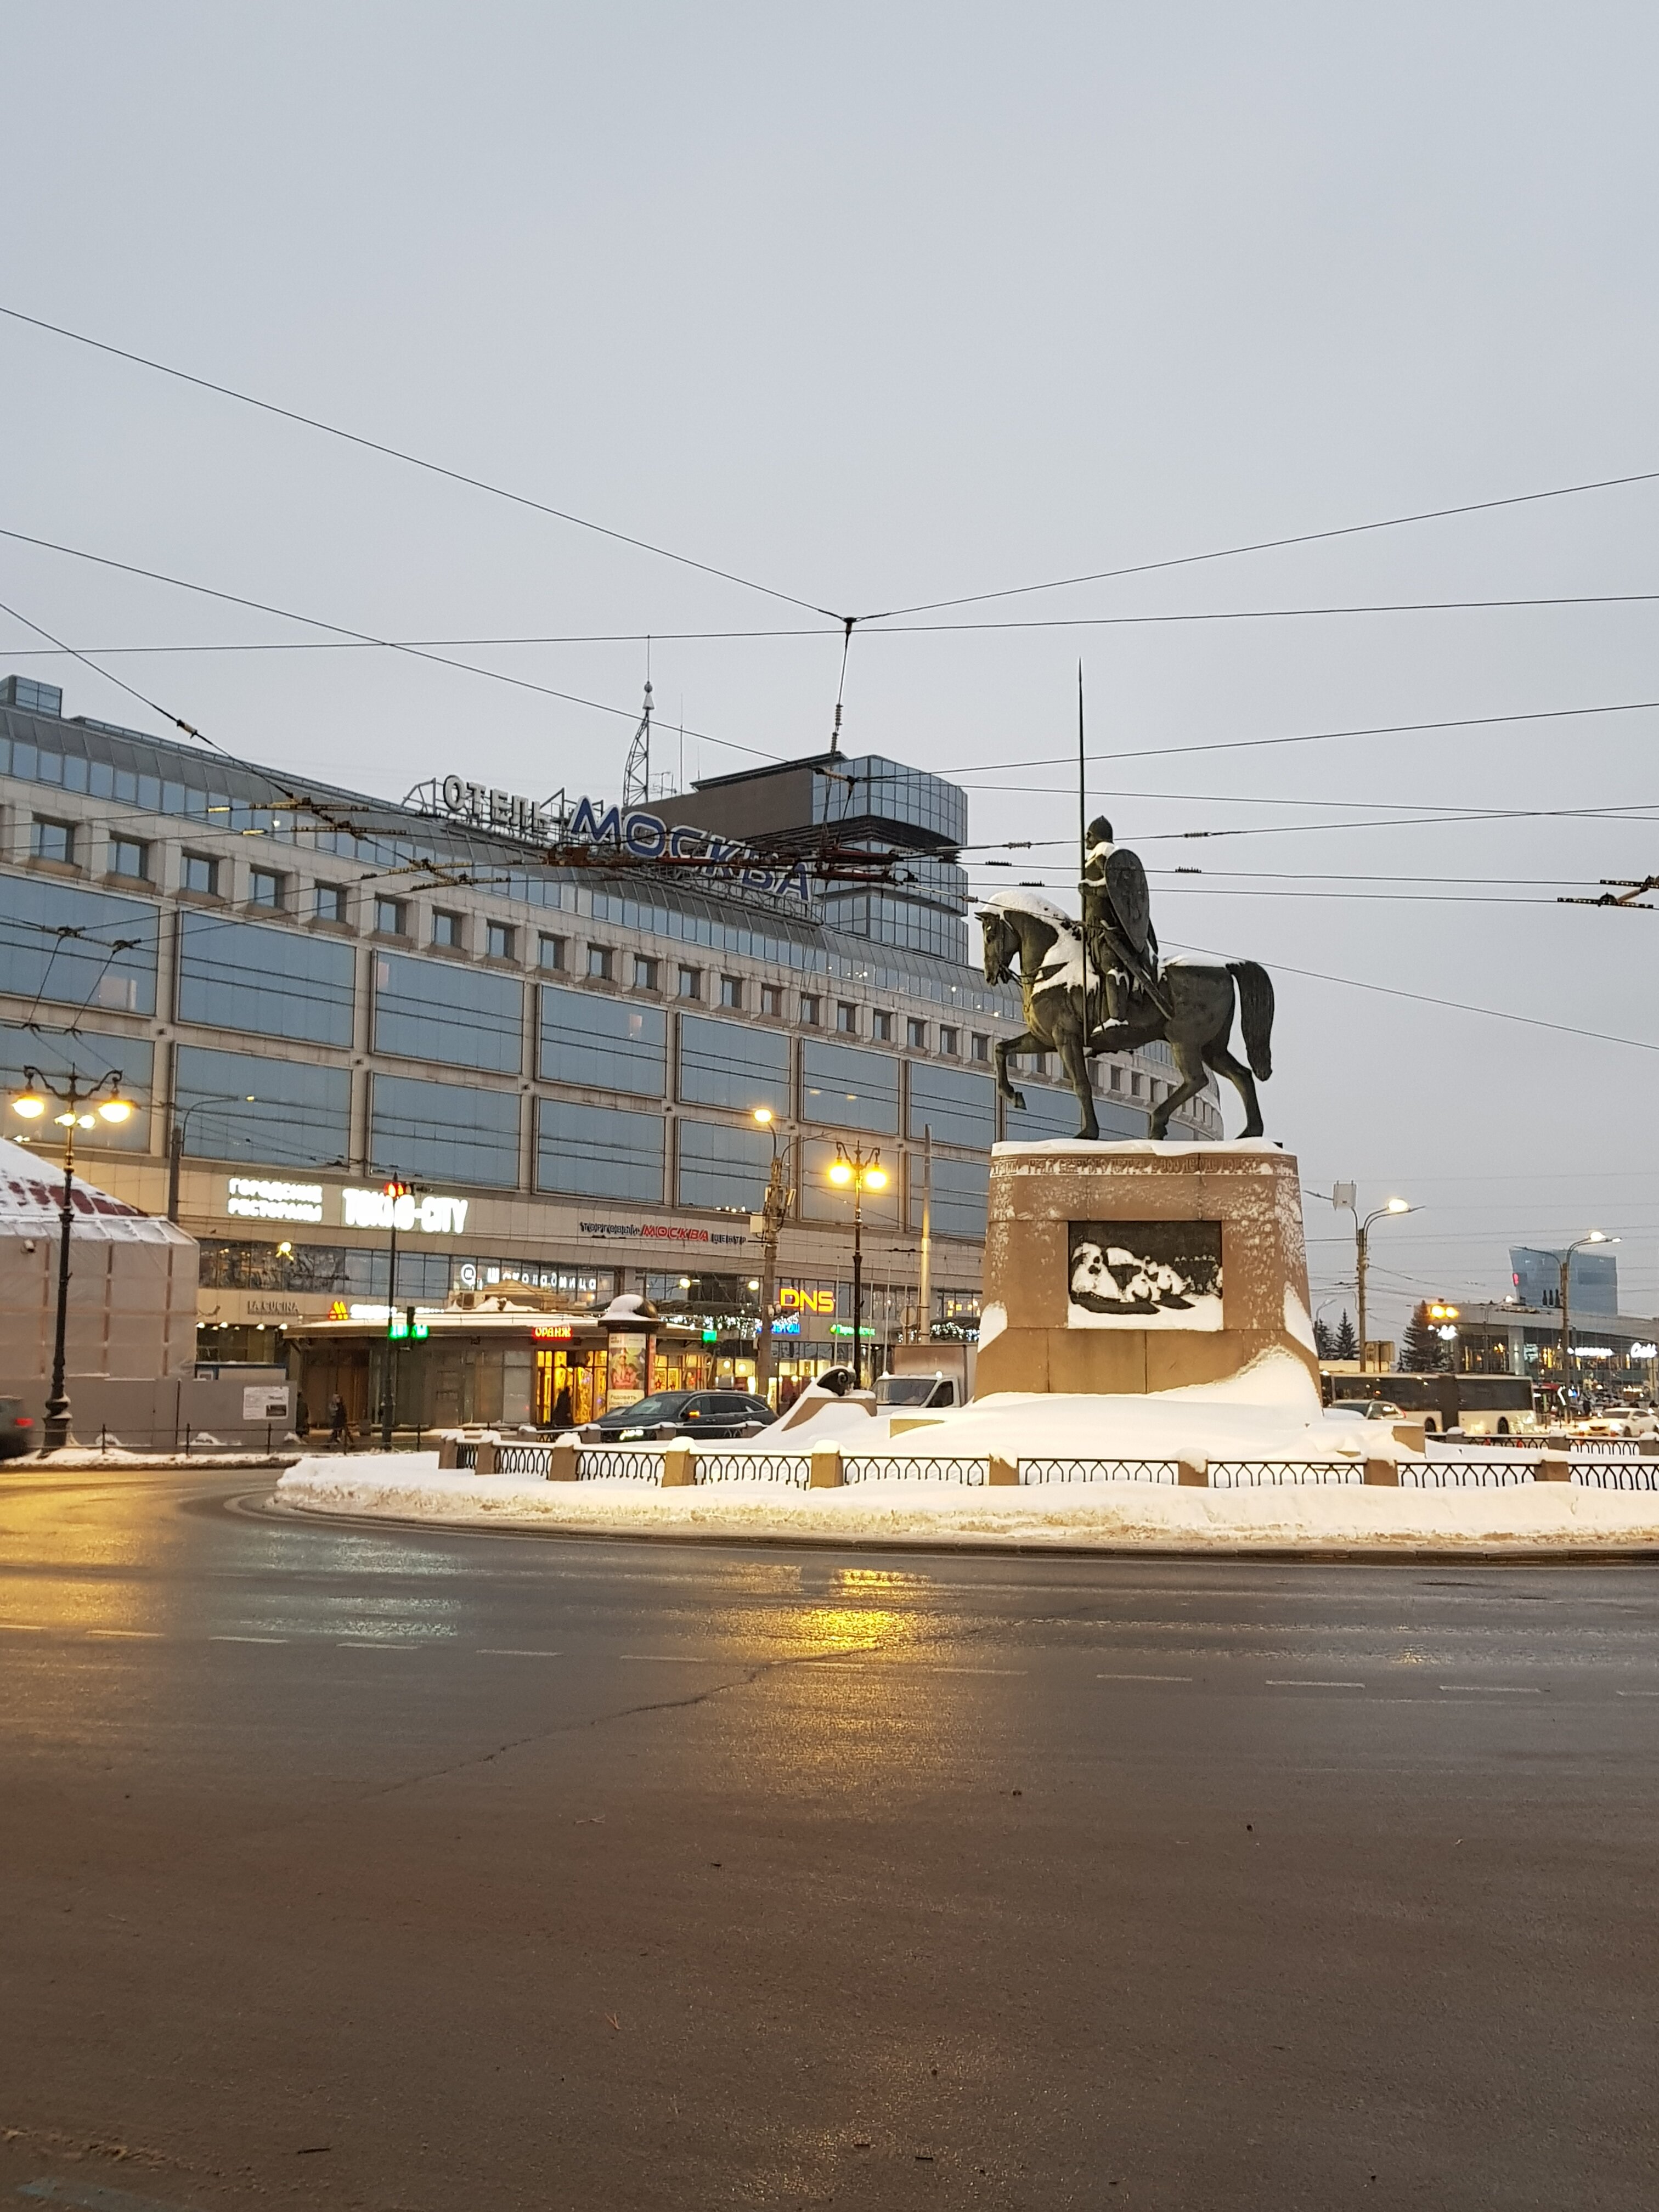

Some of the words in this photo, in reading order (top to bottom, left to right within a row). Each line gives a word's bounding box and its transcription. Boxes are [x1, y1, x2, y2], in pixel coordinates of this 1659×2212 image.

[443, 774, 552, 834] ОТЕЛЬ
[568, 794, 810, 903] МОСКВА
[580, 1221, 638, 1237] ТОРГОВЫЙ
[641, 1223, 709, 1243] МОСКВА
[711, 1233, 746, 1245] ЦЕНТР
[487, 1267, 597, 1290] Шоколадница
[261, 1300, 299, 1315] CUCINA
[780, 1288, 835, 1313] DNS
[534, 1326, 572, 1338] ОРАНЖ
